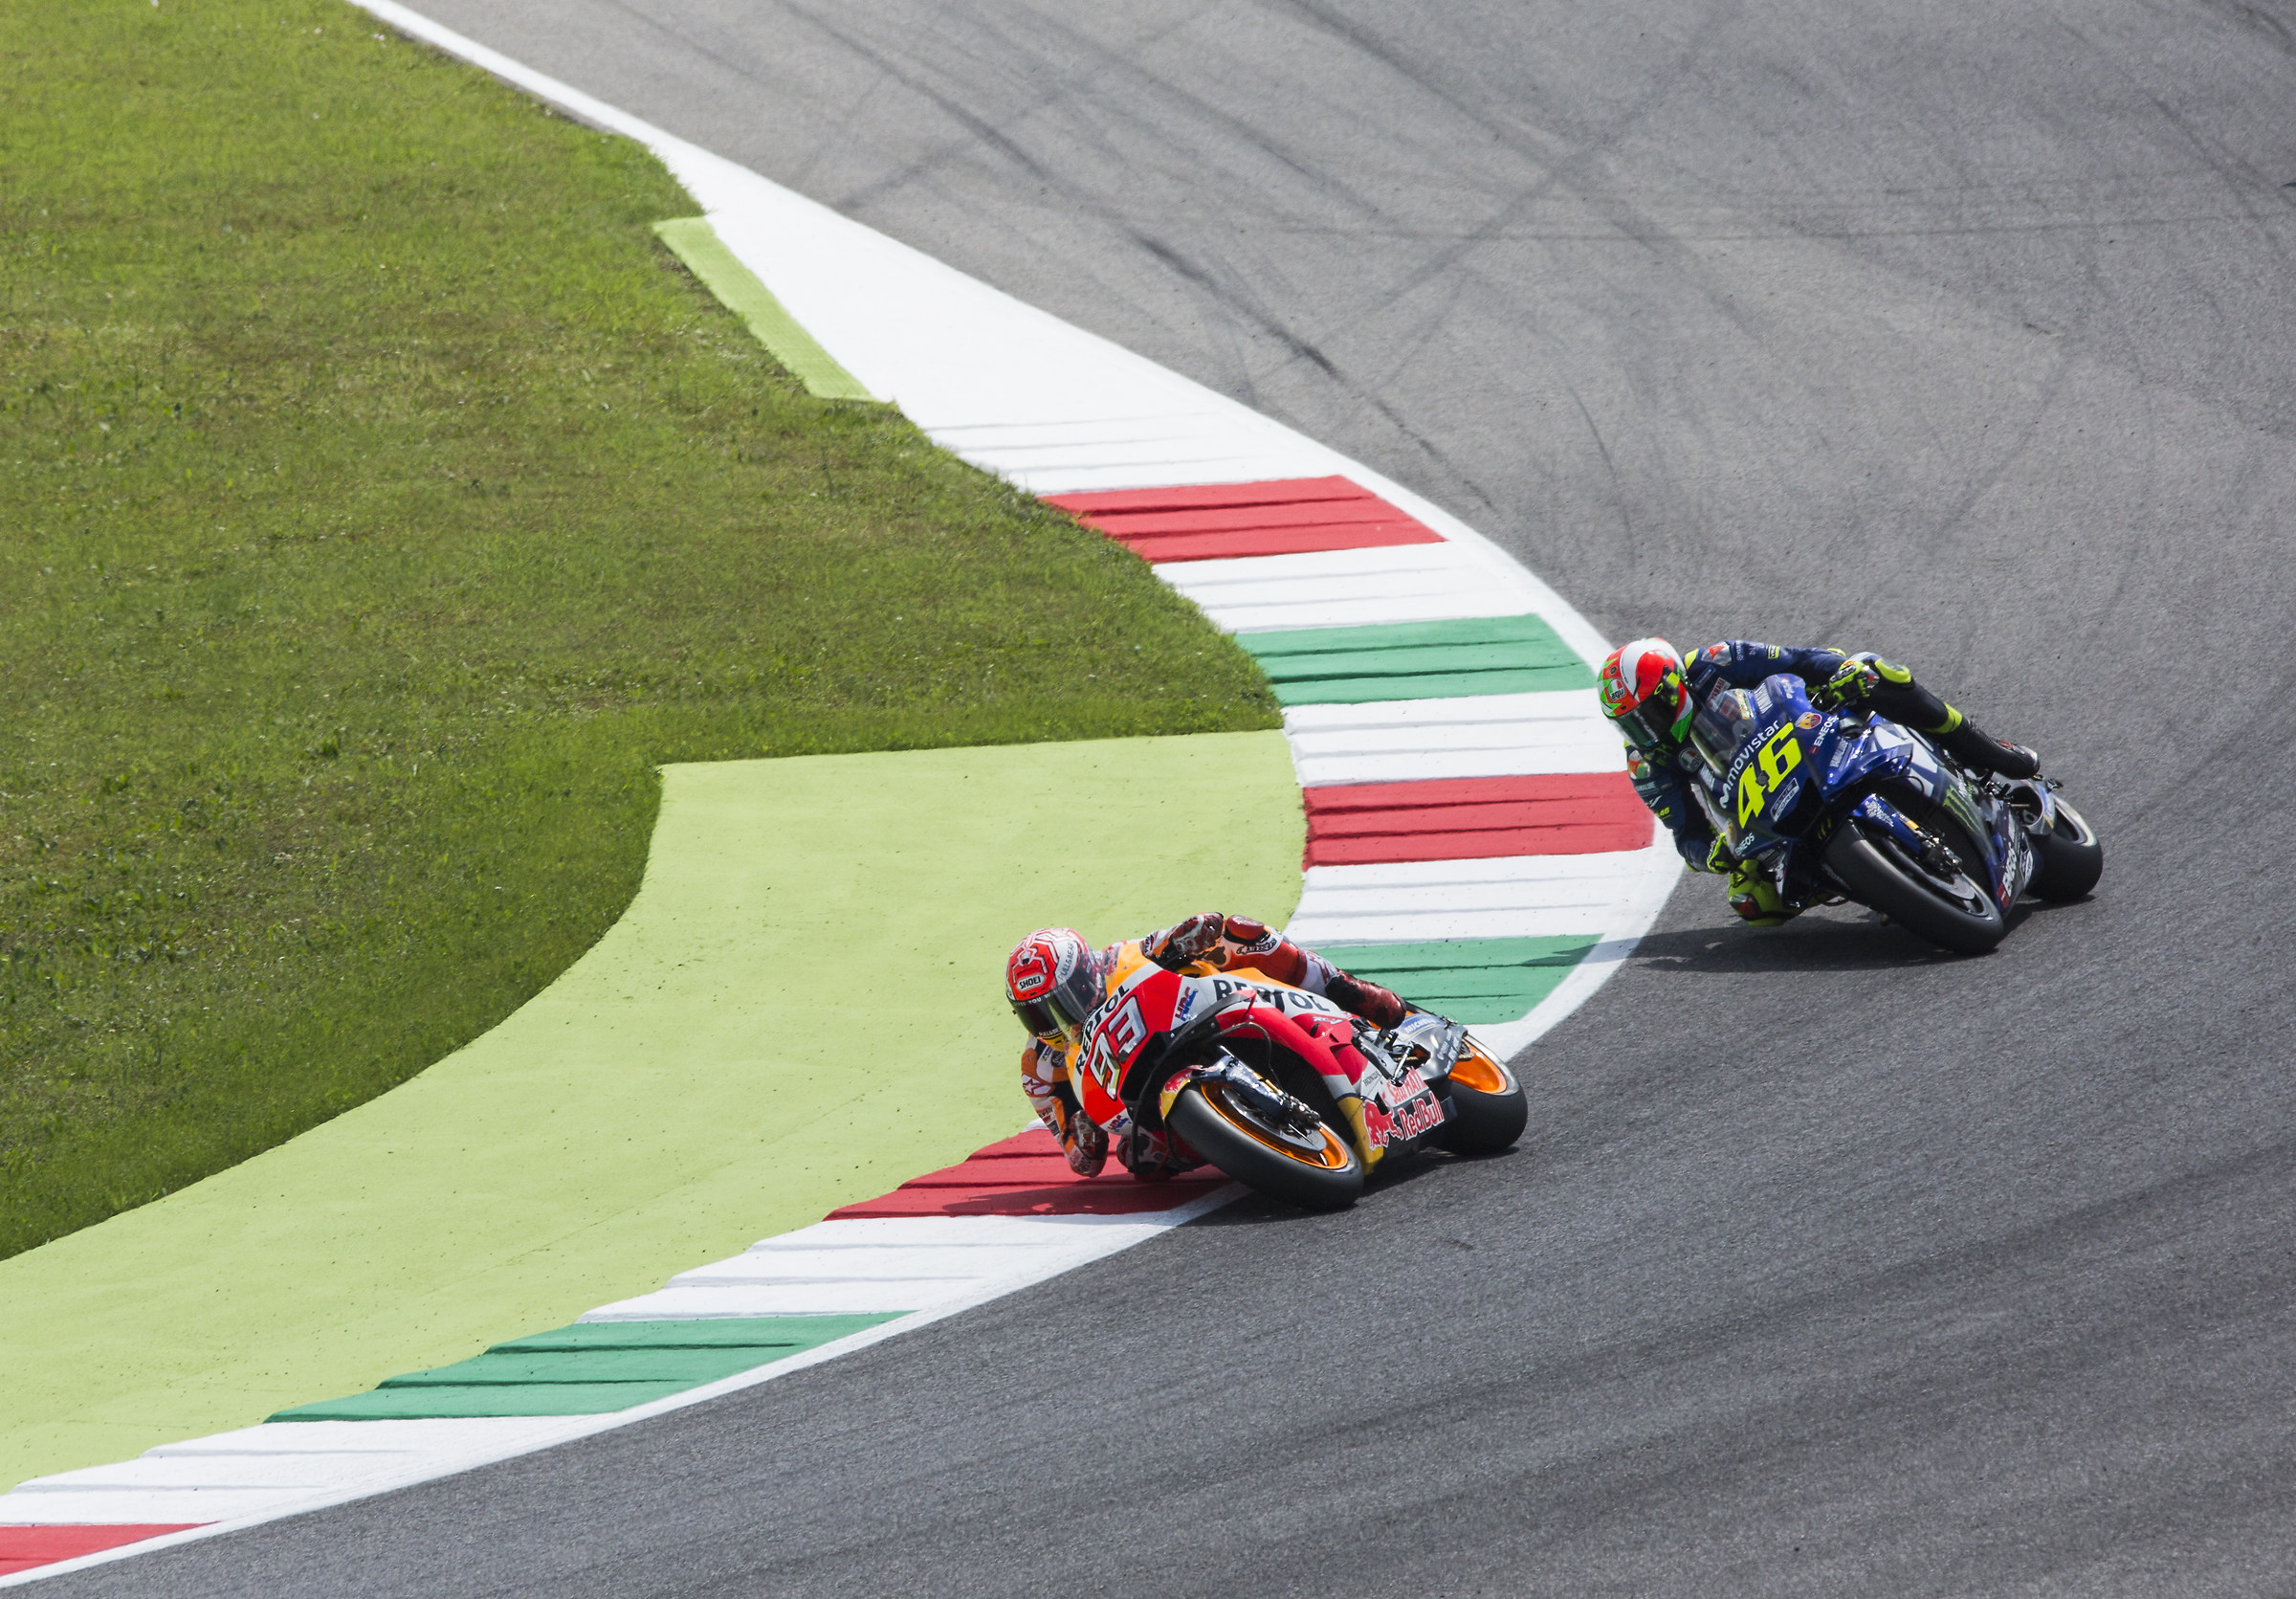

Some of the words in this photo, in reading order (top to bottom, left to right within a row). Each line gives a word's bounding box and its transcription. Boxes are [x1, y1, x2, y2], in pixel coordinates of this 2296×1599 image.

[1728, 720, 1779, 788] movistar
[1814, 715, 1836, 747] ENEOS
[1738, 722, 1801, 829] 46
[1734, 833, 1755, 856] ENEOS
[1019, 976, 1042, 989] SHOEI
[1075, 985, 1130, 1076] REPSOL
[1090, 994, 1149, 1101] 93
[1363, 1070, 1380, 1086] HONDA
[1398, 1099, 1424, 1141] Red
[1417, 1091, 1446, 1133] Bull
